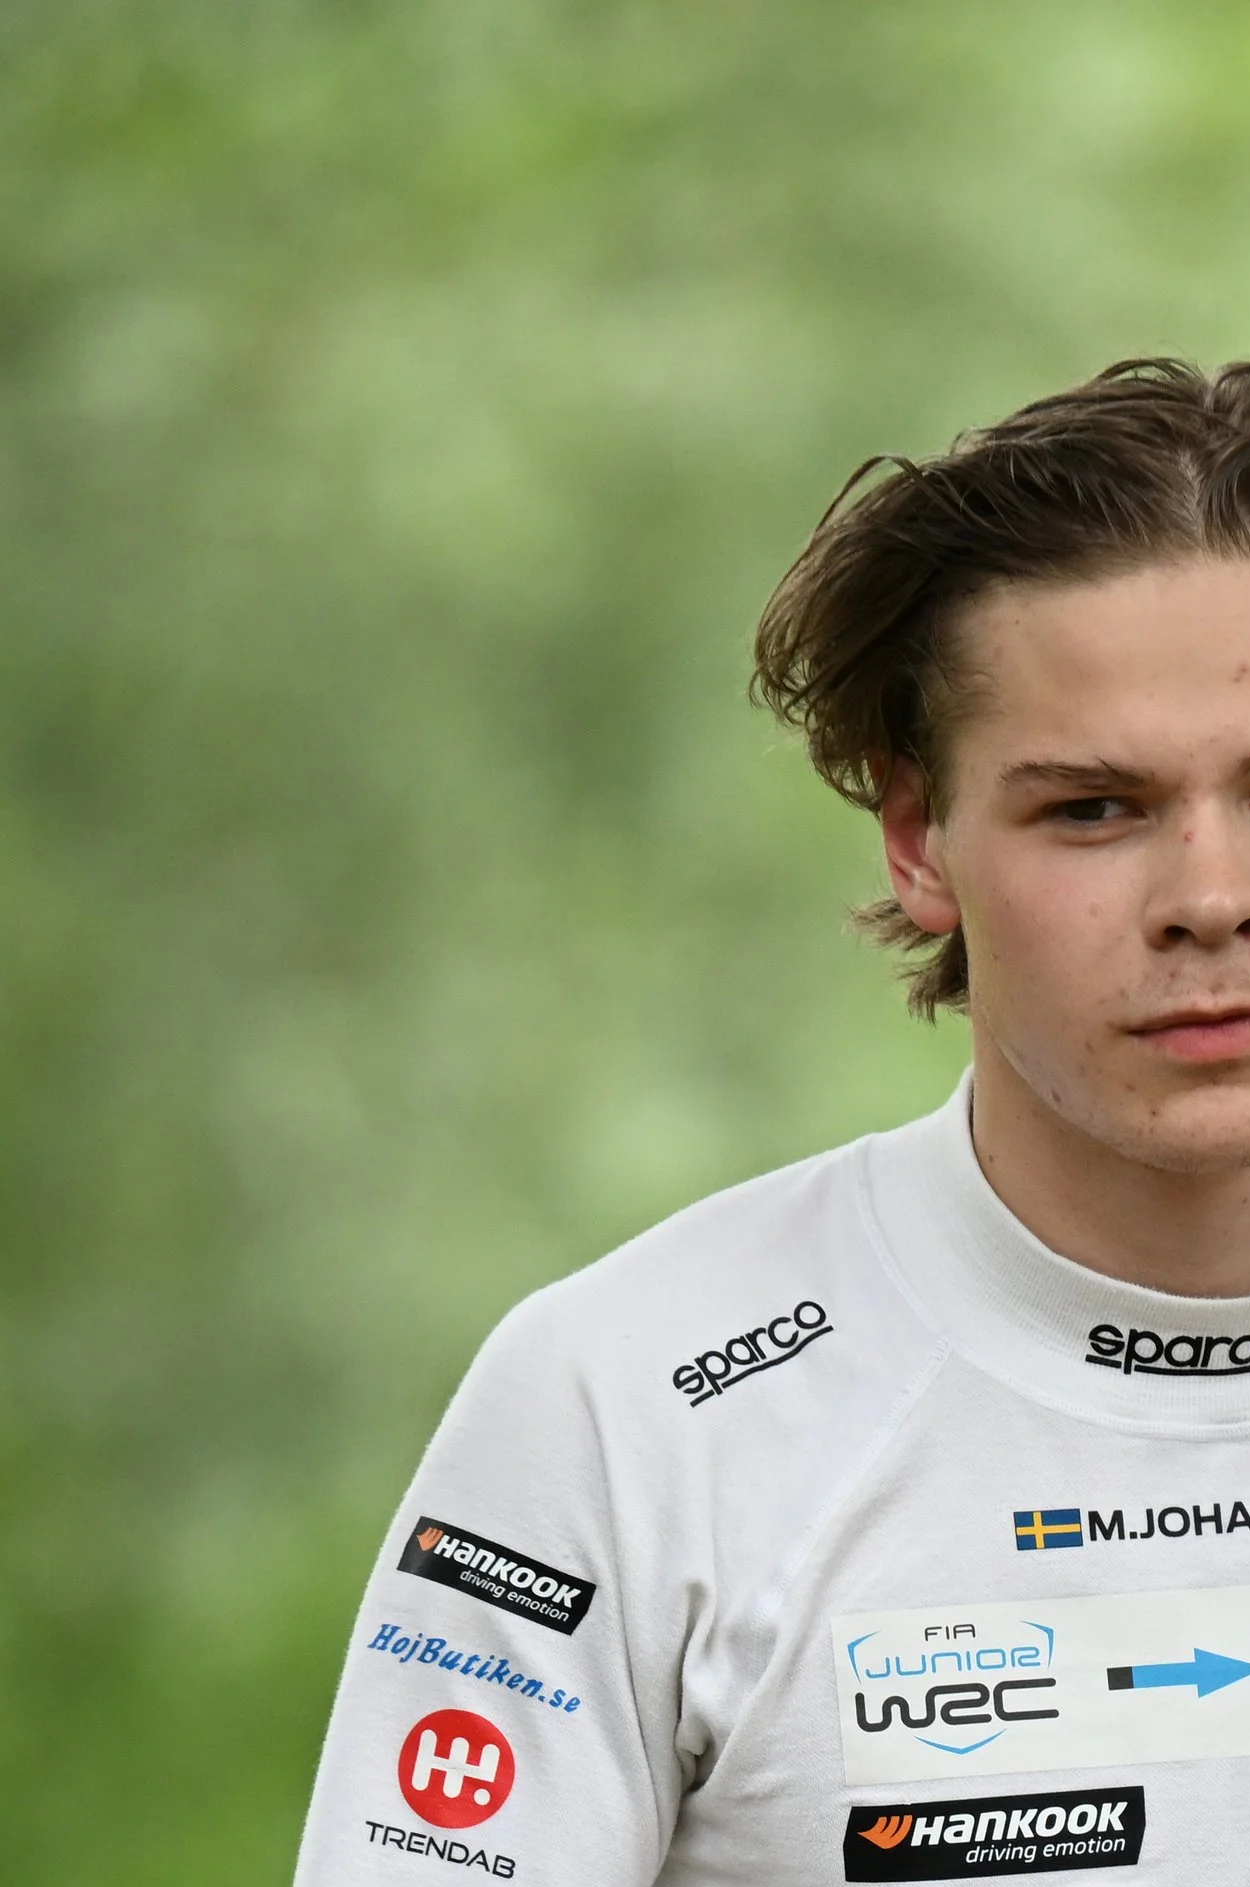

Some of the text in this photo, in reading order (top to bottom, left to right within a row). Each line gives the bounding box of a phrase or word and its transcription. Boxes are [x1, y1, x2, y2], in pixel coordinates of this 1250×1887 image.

[673, 1301, 830, 1400] sparco
[460, 1569, 570, 1623] driving emotion
[925, 1623, 976, 1641] FIA
[865, 1646, 1041, 1680] JUNIOR
[855, 1677, 1060, 1733] WRC
[365, 1820, 516, 1880] TRENDAB
[965, 1837, 1126, 1865] driving emotion
